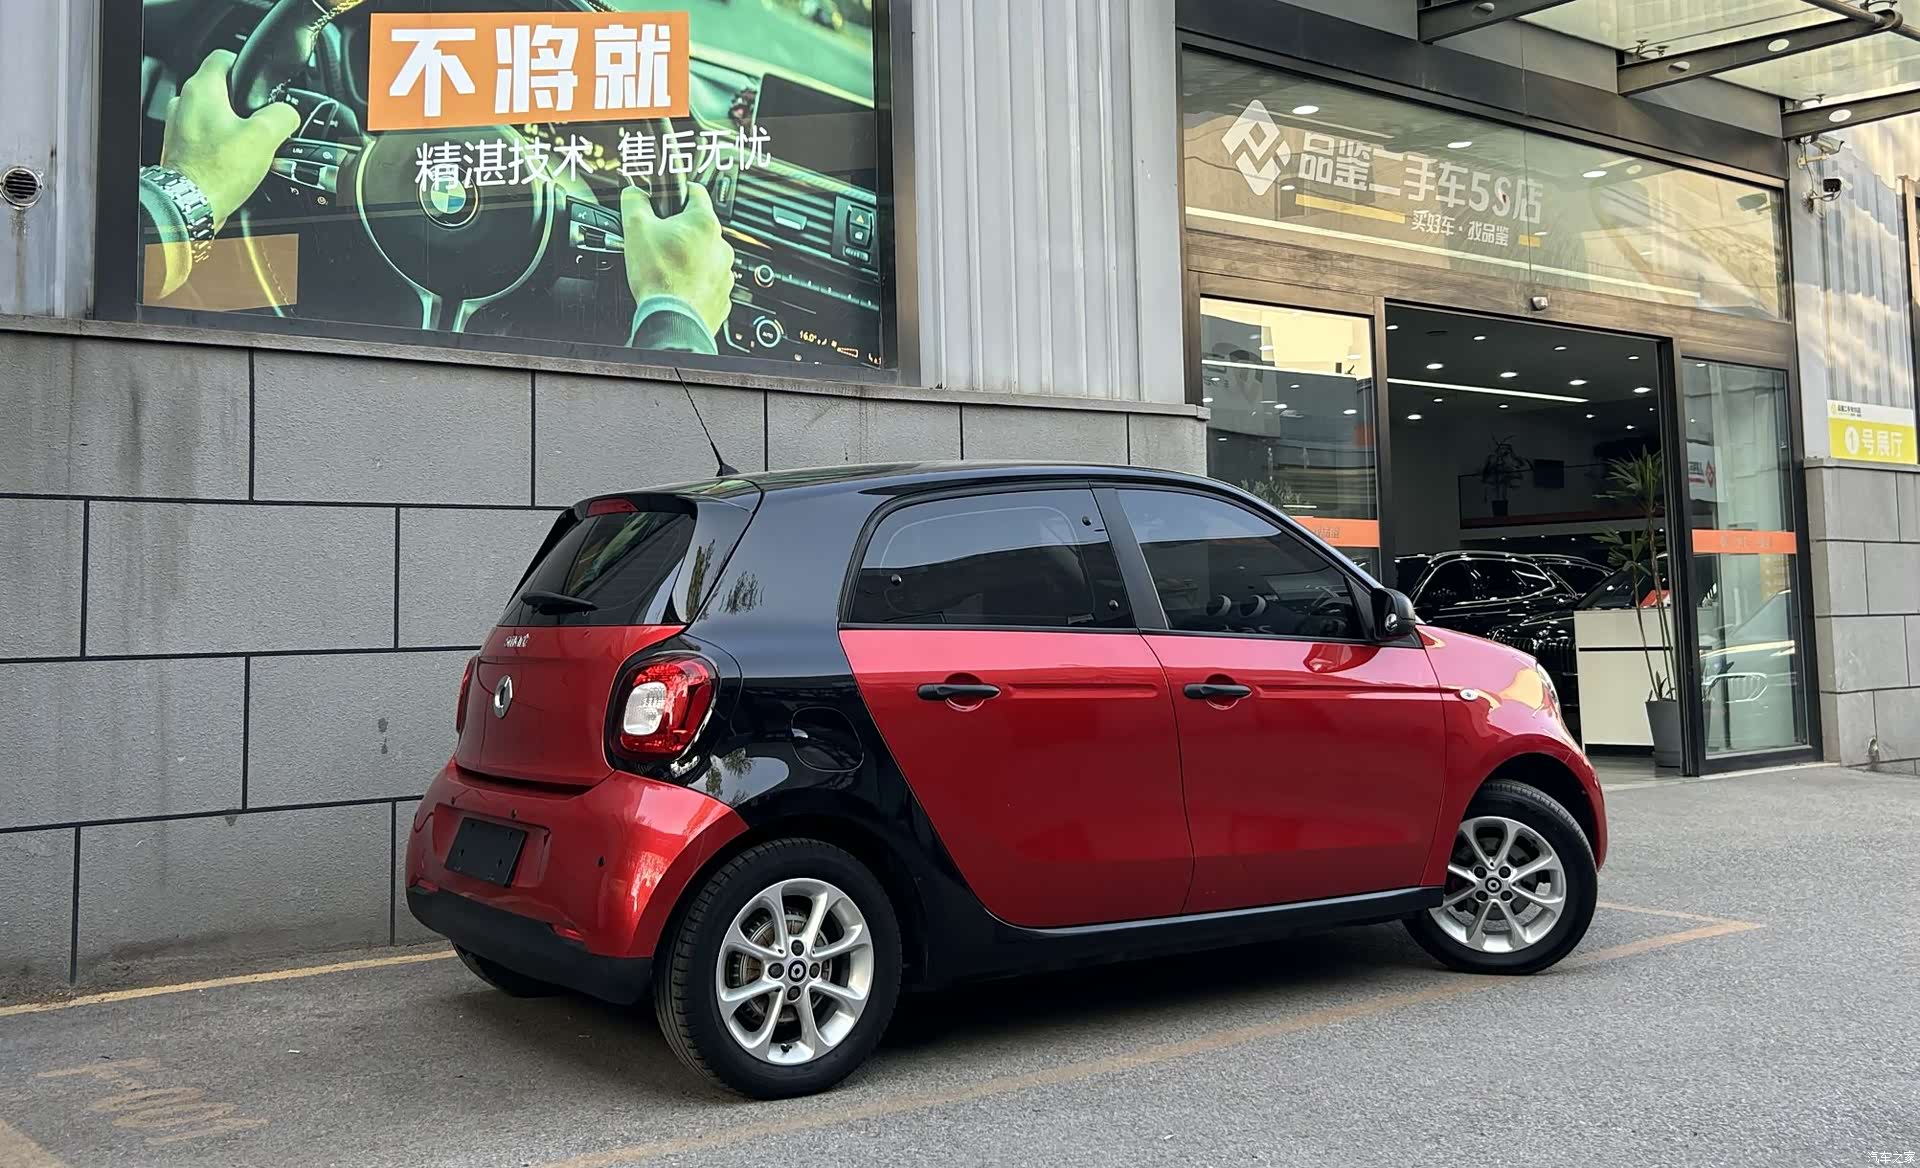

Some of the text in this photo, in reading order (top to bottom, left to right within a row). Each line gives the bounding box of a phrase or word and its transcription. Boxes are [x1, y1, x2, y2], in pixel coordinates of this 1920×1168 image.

[389, 24, 671, 117] 不将就
[414, 125, 772, 194] 精湛技术 售后无忧
[1297, 131, 1544, 225] 品鉴二手车5S店
